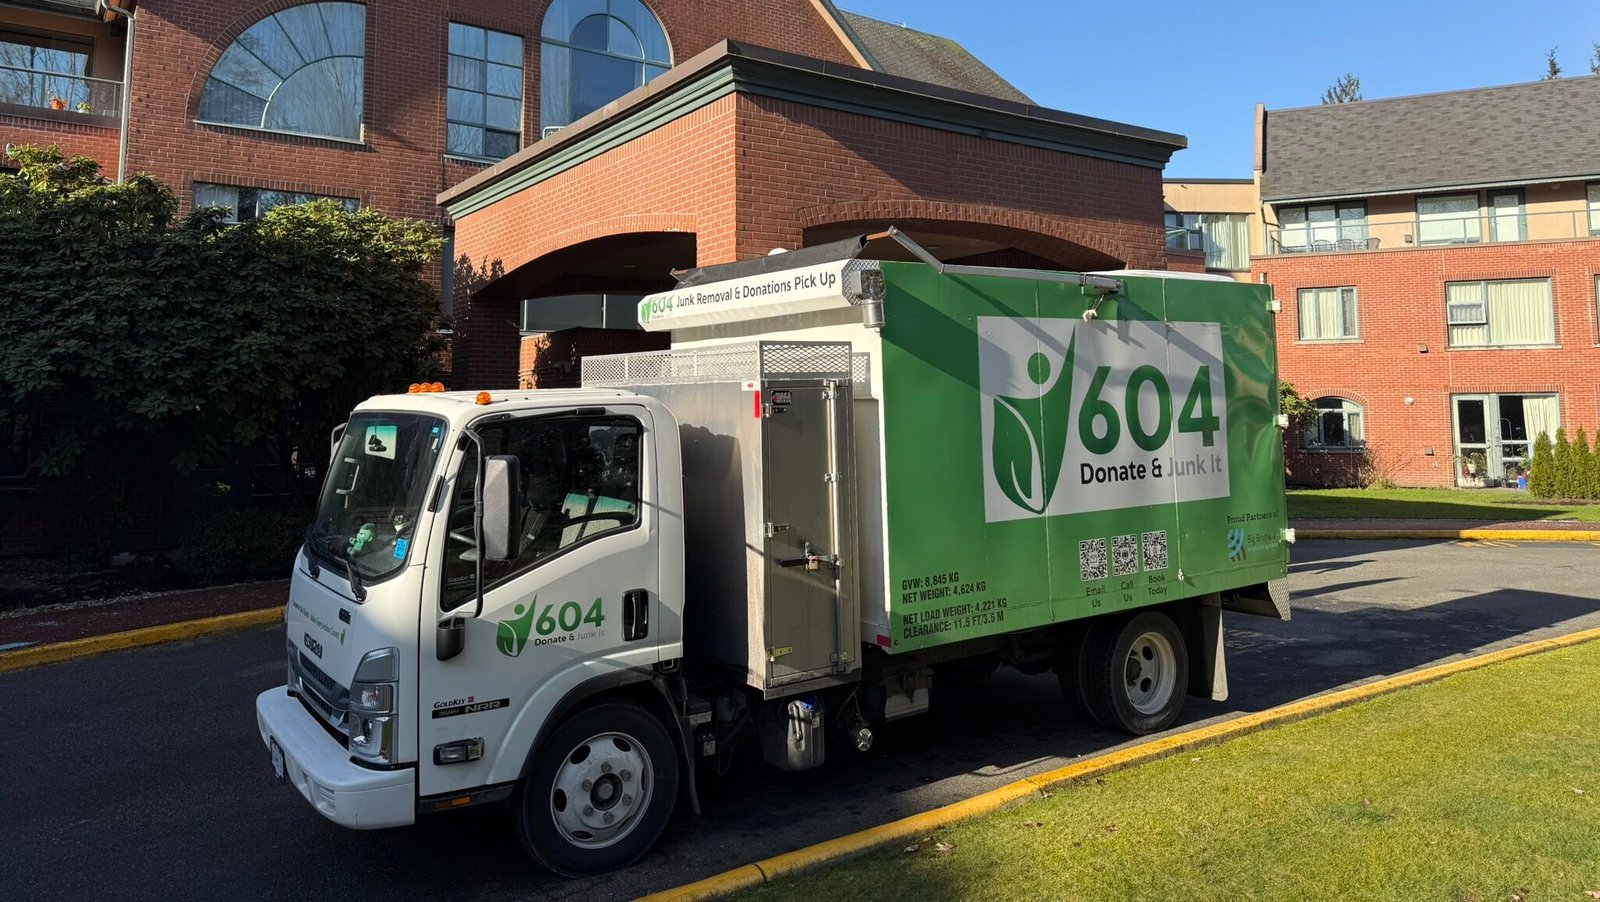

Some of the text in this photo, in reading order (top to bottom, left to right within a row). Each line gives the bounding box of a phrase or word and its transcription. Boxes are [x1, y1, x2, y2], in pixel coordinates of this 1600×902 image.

[677, 272, 836, 308] Junk Removal & Donations Pick Up
[651, 295, 675, 313] 604
[1078, 364, 1220, 455] 604
[1080, 454, 1222, 485] Donate & Junk It
[1226, 508, 1279, 524] Proud Partners of
[902, 571, 959, 590] GVW: 8,845 KG
[1120, 580, 1134, 591] Call
[1148, 573, 1166, 584] Book
[902, 581, 986, 604] NET WEIGHT: 4,624 KG
[1085, 583, 1106, 597] Email
[1123, 593, 1133, 602] Us
[1147, 585, 1168, 597] Today
[903, 613, 918, 625] NET
[920, 608, 940, 622] LOAD
[942, 603, 973, 618] WEIGHT:
[997, 597, 1007, 609] KG
[1091, 599, 1101, 608] Us
[535, 597, 605, 636] 604
[903, 610, 1004, 639] CLEARANCE: 11.5 FT/3.5 M
[534, 629, 605, 646] Donate & Junk It
[439, 701, 500, 716] ISUZU NRR
